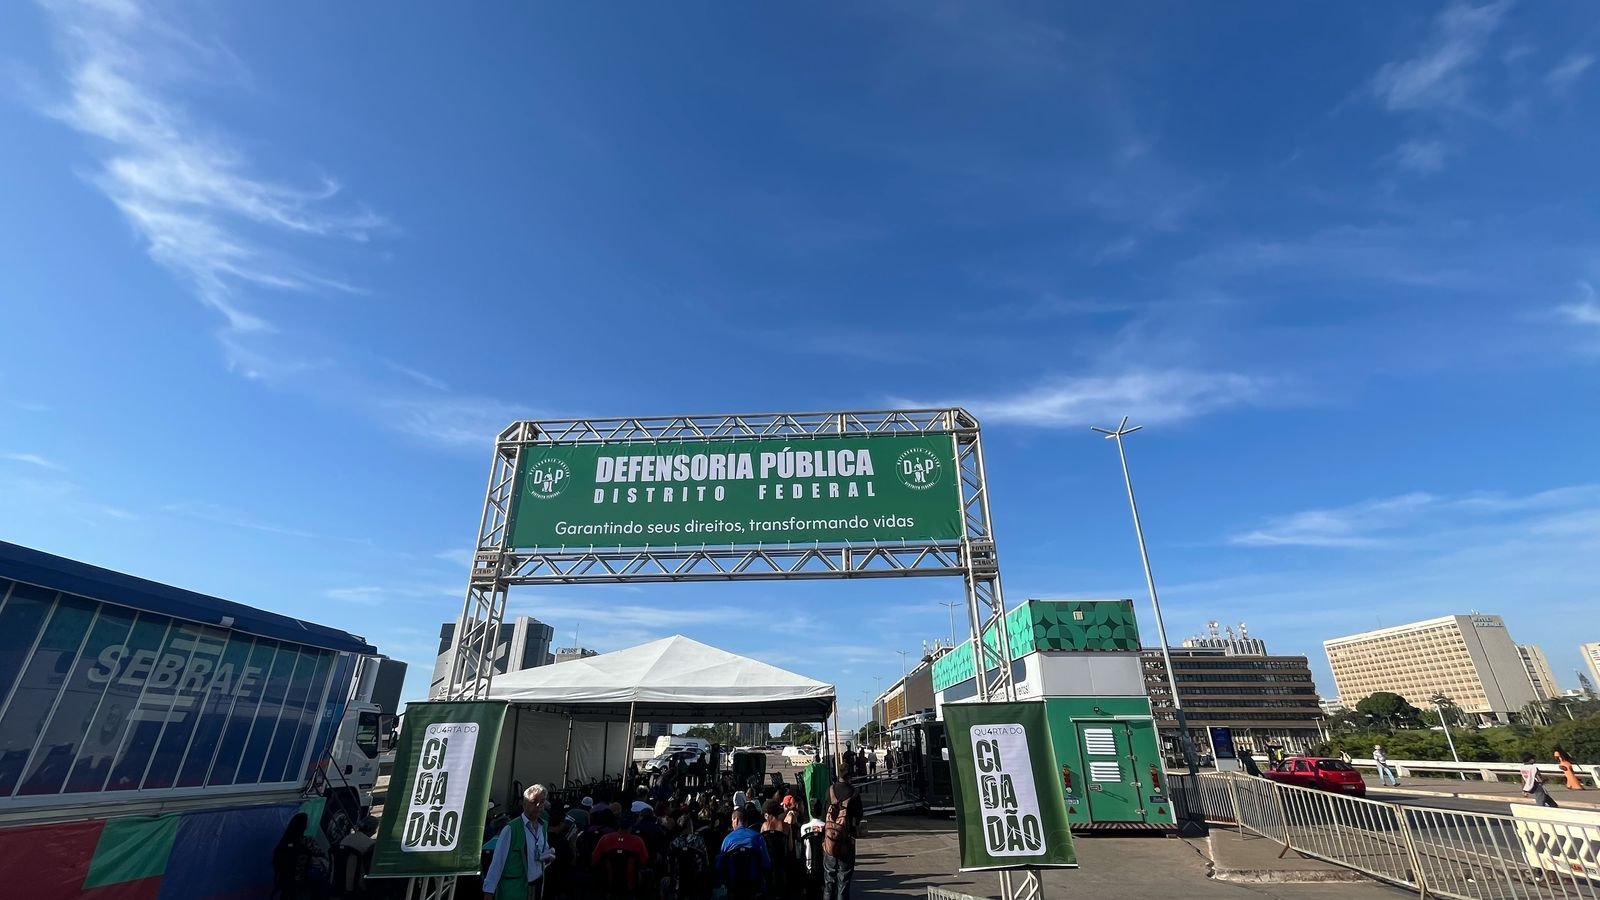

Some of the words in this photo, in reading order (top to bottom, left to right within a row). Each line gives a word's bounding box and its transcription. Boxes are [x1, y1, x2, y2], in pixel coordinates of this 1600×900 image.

[534, 469, 543, 484] D
[554, 469, 564, 484] P
[595, 453, 754, 483] DEFENSORIA
[760, 446, 875, 479] PÚBLICA
[903, 460, 912, 475] D
[925, 459, 934, 474] P
[593, 485, 725, 504] DISTRITO
[758, 481, 876, 500] FEDERAL
[555, 520, 643, 535] Garantindo
[647, 521, 681, 534] seus
[684, 519, 745, 534] direitos,
[749, 515, 869, 532] transformando
[872, 513, 914, 529] vidas
[88, 644, 262, 697] SEBRAE
[429, 726, 462, 735] QU4RTA
[464, 725, 477, 733] DO
[974, 727, 1009, 736] QU4RTA
[1009, 727, 1023, 735] DO
[422, 738, 449, 770] CI
[976, 739, 1002, 773] CI
[414, 771, 449, 805] DA
[981, 774, 1018, 809] DA
[405, 805, 459, 848] DÃO
[986, 808, 1042, 852] DÃO
